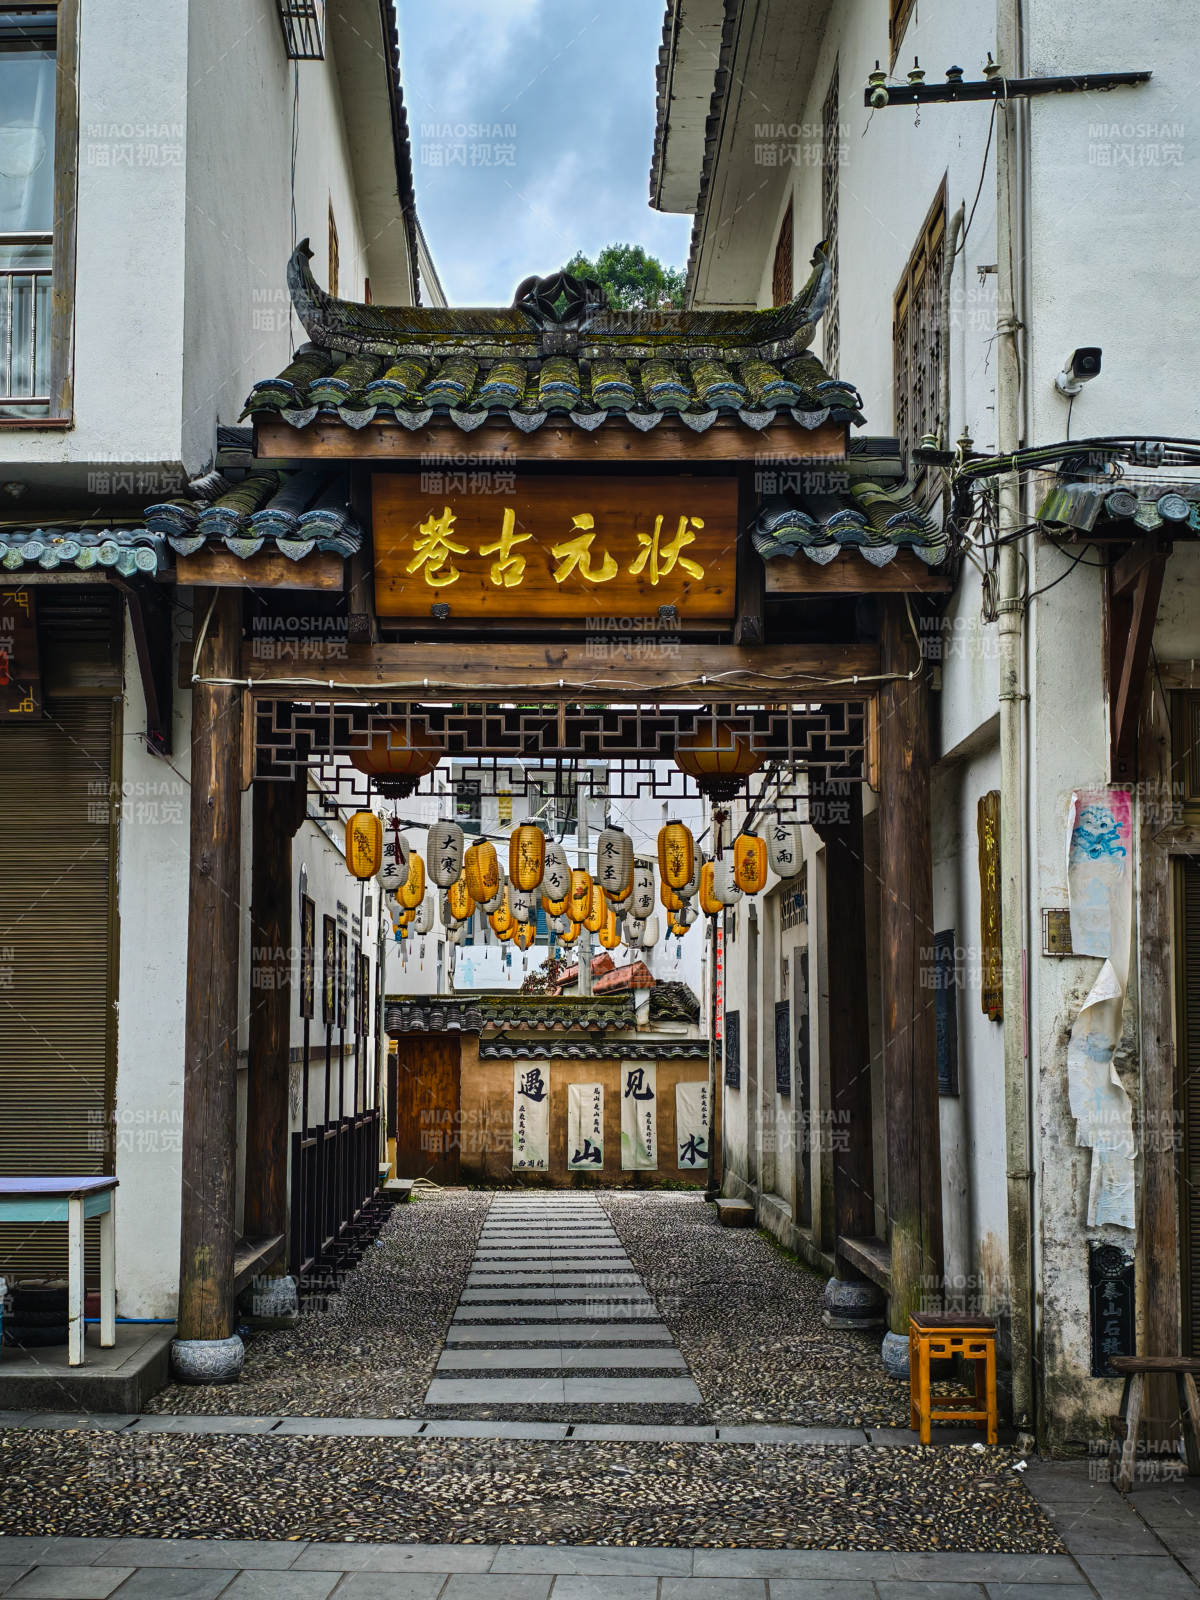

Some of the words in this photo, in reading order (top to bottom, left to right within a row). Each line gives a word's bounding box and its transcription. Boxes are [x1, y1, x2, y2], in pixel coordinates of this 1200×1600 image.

[383, 842, 399, 878] 夏至
[439, 834, 458, 874] 大寒
[601, 842, 620, 880] 冬至
[773, 825, 793, 864] 谷雨
[545, 853, 564, 888] 秋分
[638, 877, 652, 908] 小雪
[517, 1067, 548, 1103] 遇
[624, 1067, 655, 1101] 见
[571, 1138, 603, 1164] 山
[680, 1133, 713, 1166] 水
[1101, 1281, 1123, 1373] 泰山石敢
